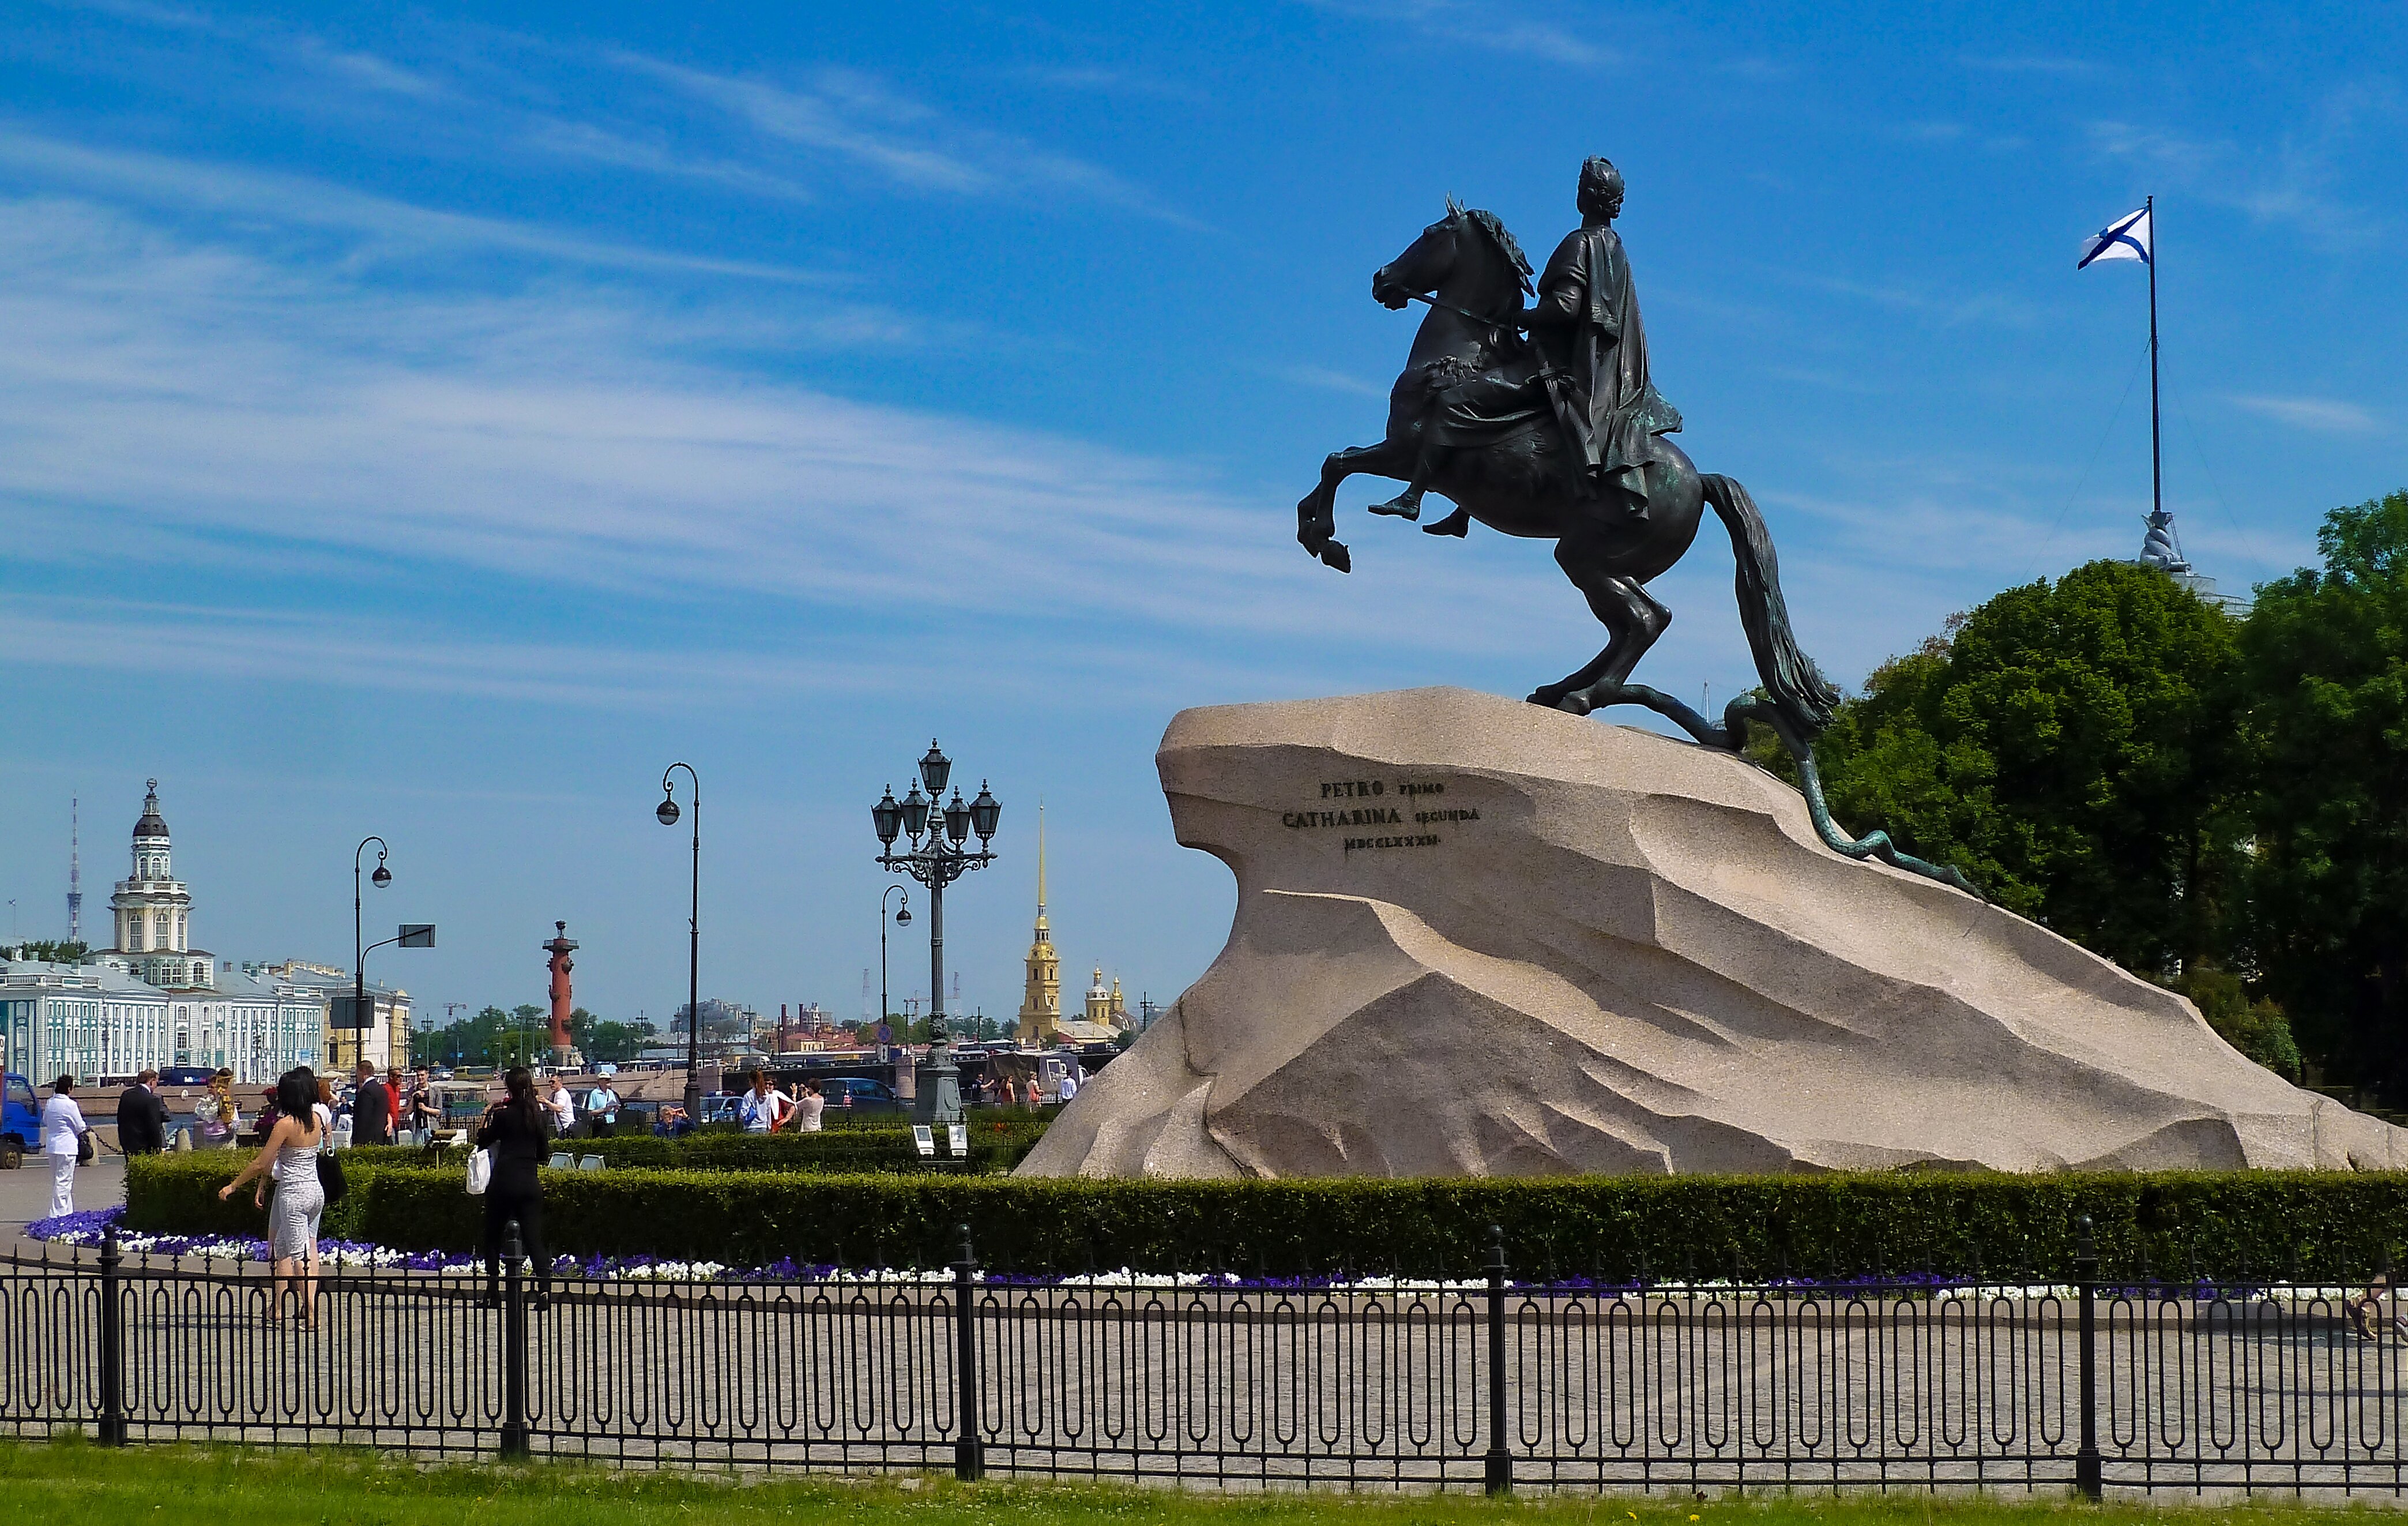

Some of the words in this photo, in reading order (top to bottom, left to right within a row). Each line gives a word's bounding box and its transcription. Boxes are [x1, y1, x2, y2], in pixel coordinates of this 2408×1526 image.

[1320, 781, 1383, 798] PETRO
[1399, 783, 1444, 795] PRIMO
[1283, 808, 1402, 828] CATHARINA
[1416, 809, 1480, 823] SECUNDA
